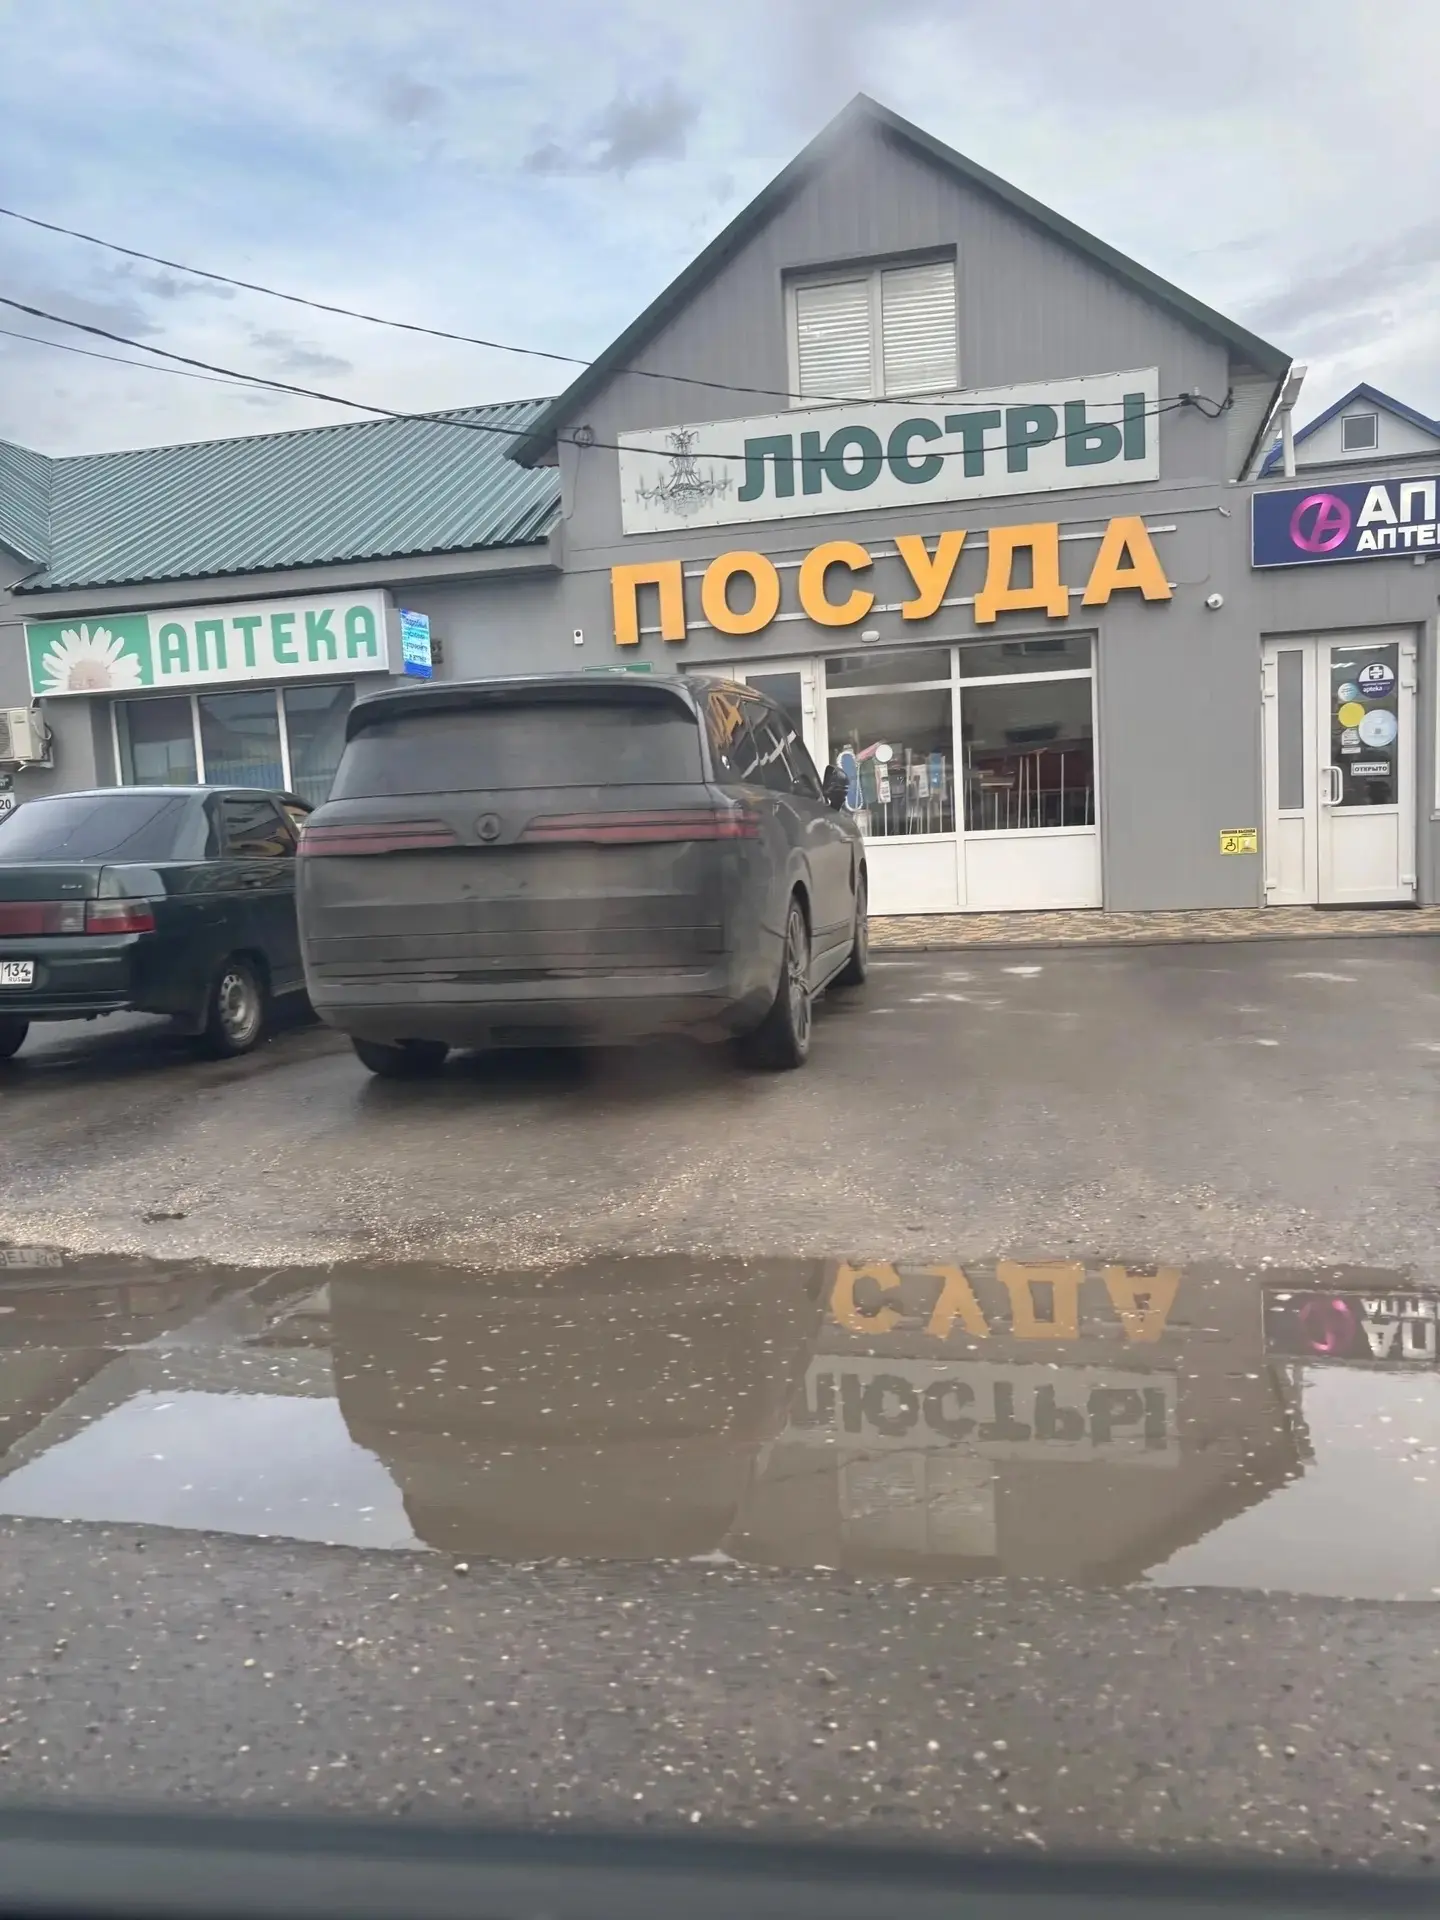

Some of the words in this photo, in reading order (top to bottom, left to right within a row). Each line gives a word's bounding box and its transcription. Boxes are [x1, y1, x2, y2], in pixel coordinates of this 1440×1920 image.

[737, 392, 1146, 502] ЛЮСТРЫ
[611, 516, 1173, 646] ПОСУДА
[1355, 523, 1440, 552] АПТЕ
[158, 605, 378, 674] АПТЕКА
